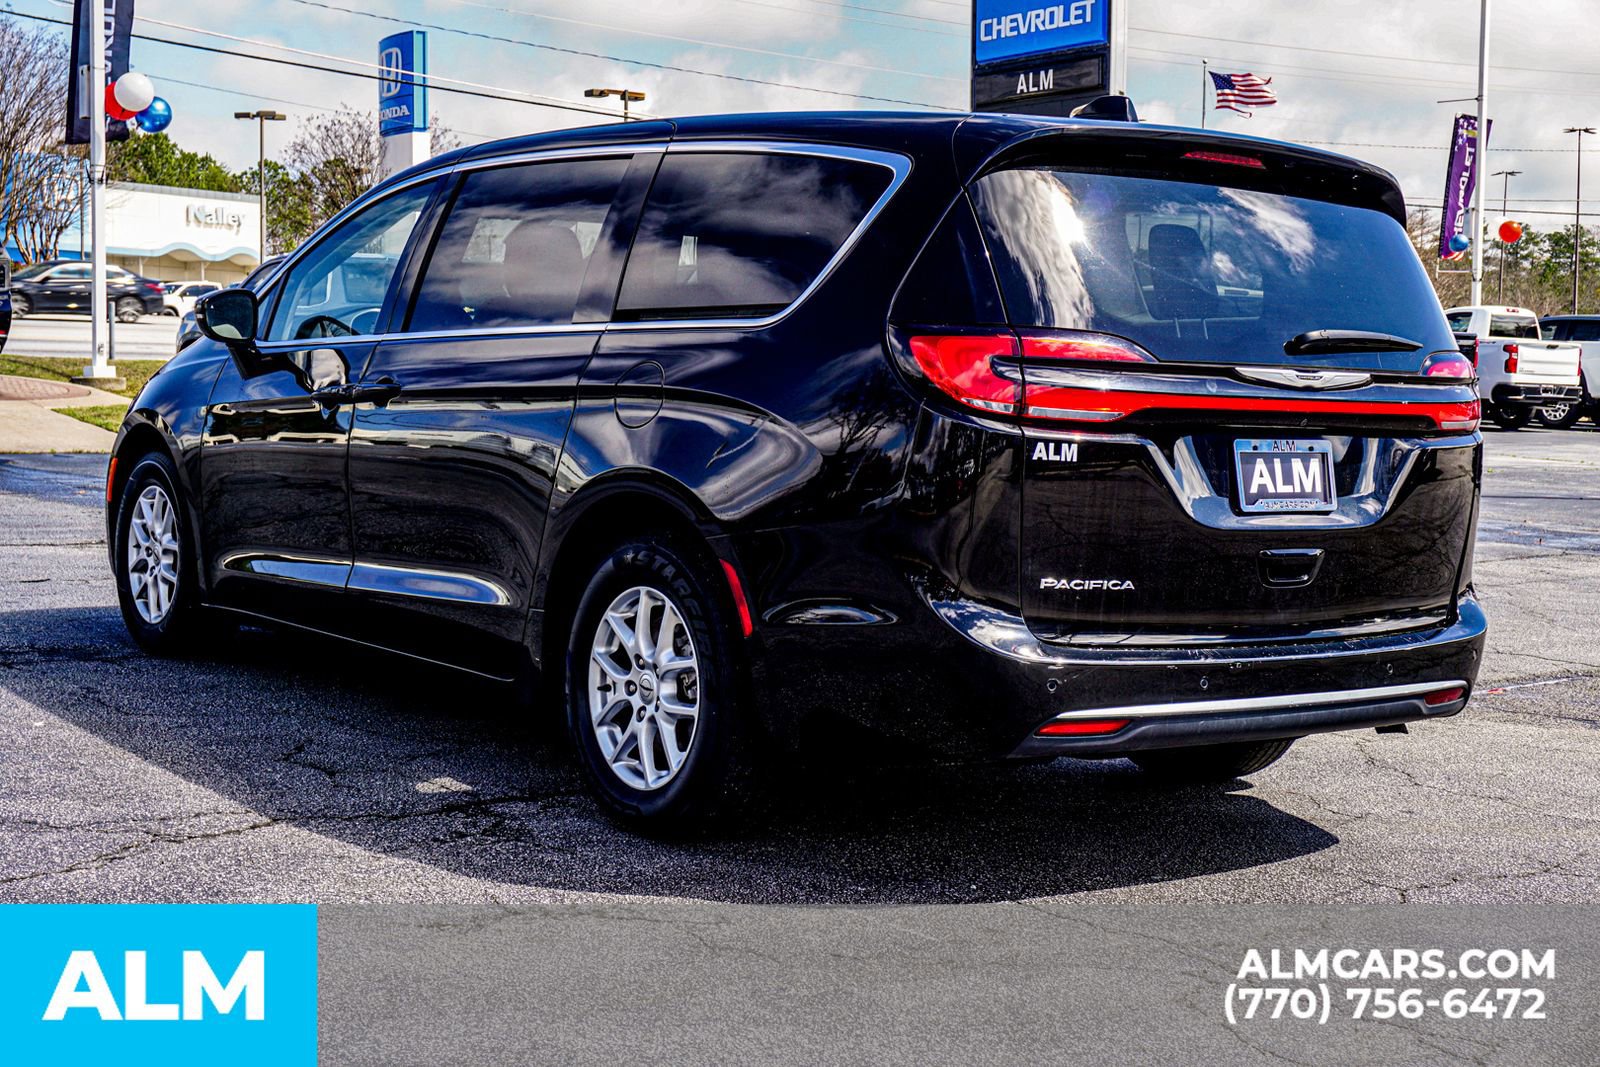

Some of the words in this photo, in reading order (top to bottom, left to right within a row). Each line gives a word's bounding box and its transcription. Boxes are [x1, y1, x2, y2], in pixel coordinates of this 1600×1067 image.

[980, 0, 1096, 42] CHEVROLET
[1016, 68, 1054, 94] ALM
[379, 104, 410, 121] ONDA
[1453, 143, 1475, 236] HEVROLET
[185, 204, 245, 234] Nalley
[1032, 442, 1078, 462] ALM
[1273, 440, 1296, 452] ALM
[1249, 457, 1322, 494] ALM
[1039, 577, 1136, 591] PACIFICA
